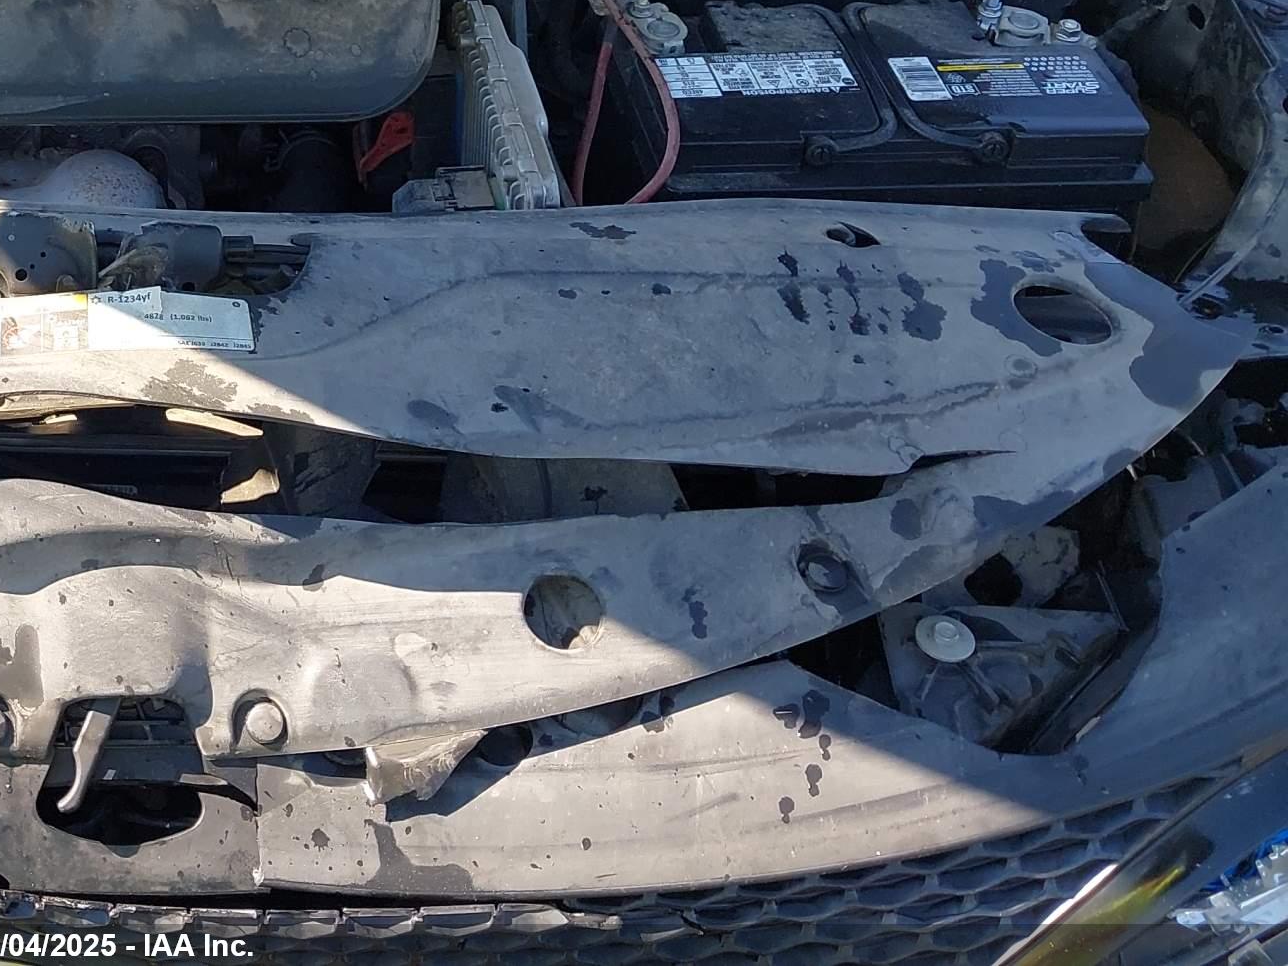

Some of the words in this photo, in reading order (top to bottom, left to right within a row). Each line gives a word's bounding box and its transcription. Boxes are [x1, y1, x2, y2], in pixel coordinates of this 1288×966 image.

[1042, 81, 1100, 89] START
[1046, 87, 1098, 95] SUPER
[107, 292, 152, 304] R-1234yf
